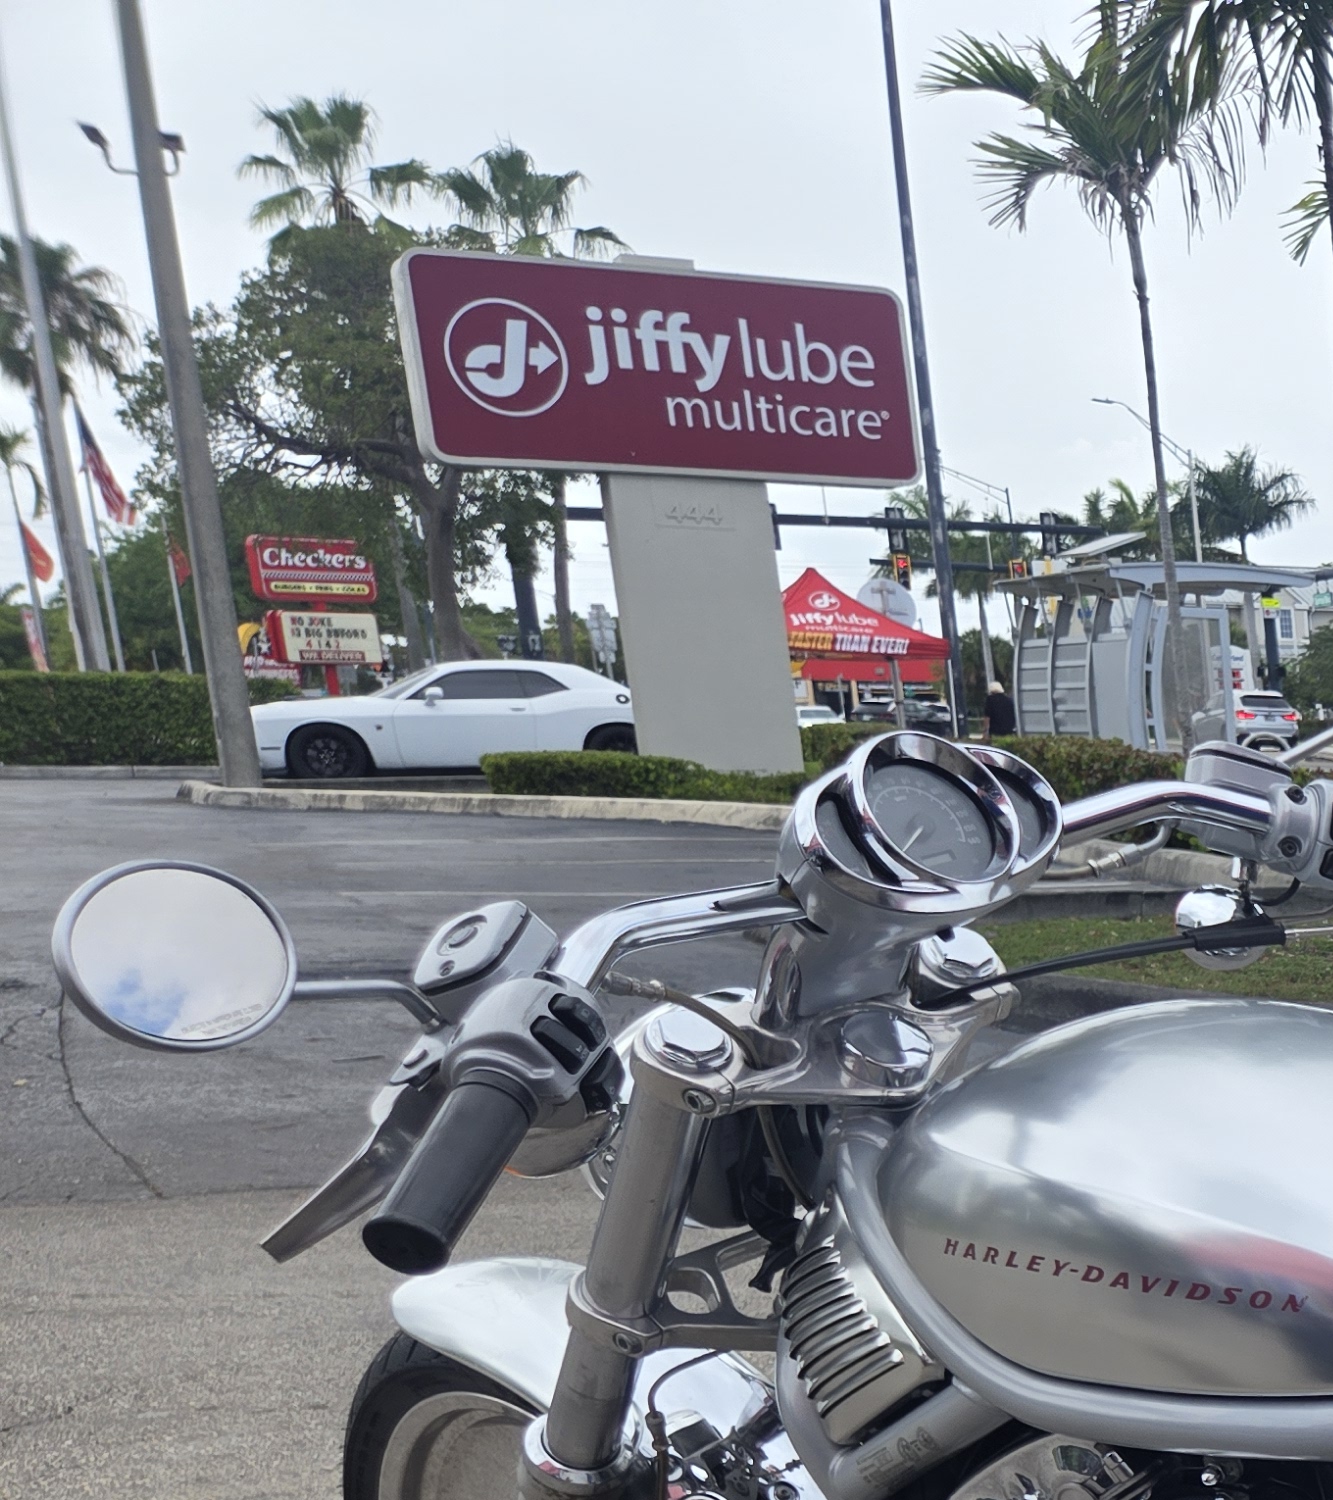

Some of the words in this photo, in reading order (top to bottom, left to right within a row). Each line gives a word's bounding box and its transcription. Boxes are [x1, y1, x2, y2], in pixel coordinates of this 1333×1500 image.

[738, 317, 875, 388] lube
[664, 504, 723, 525] 444
[262, 547, 367, 569] Checkers
[789, 631, 834, 650] FASTER
[835, 634, 871, 652] THAN
[871, 636, 910, 655] EVER!
[943, 1237, 1310, 1314] HARLEY-DAVIDSON
